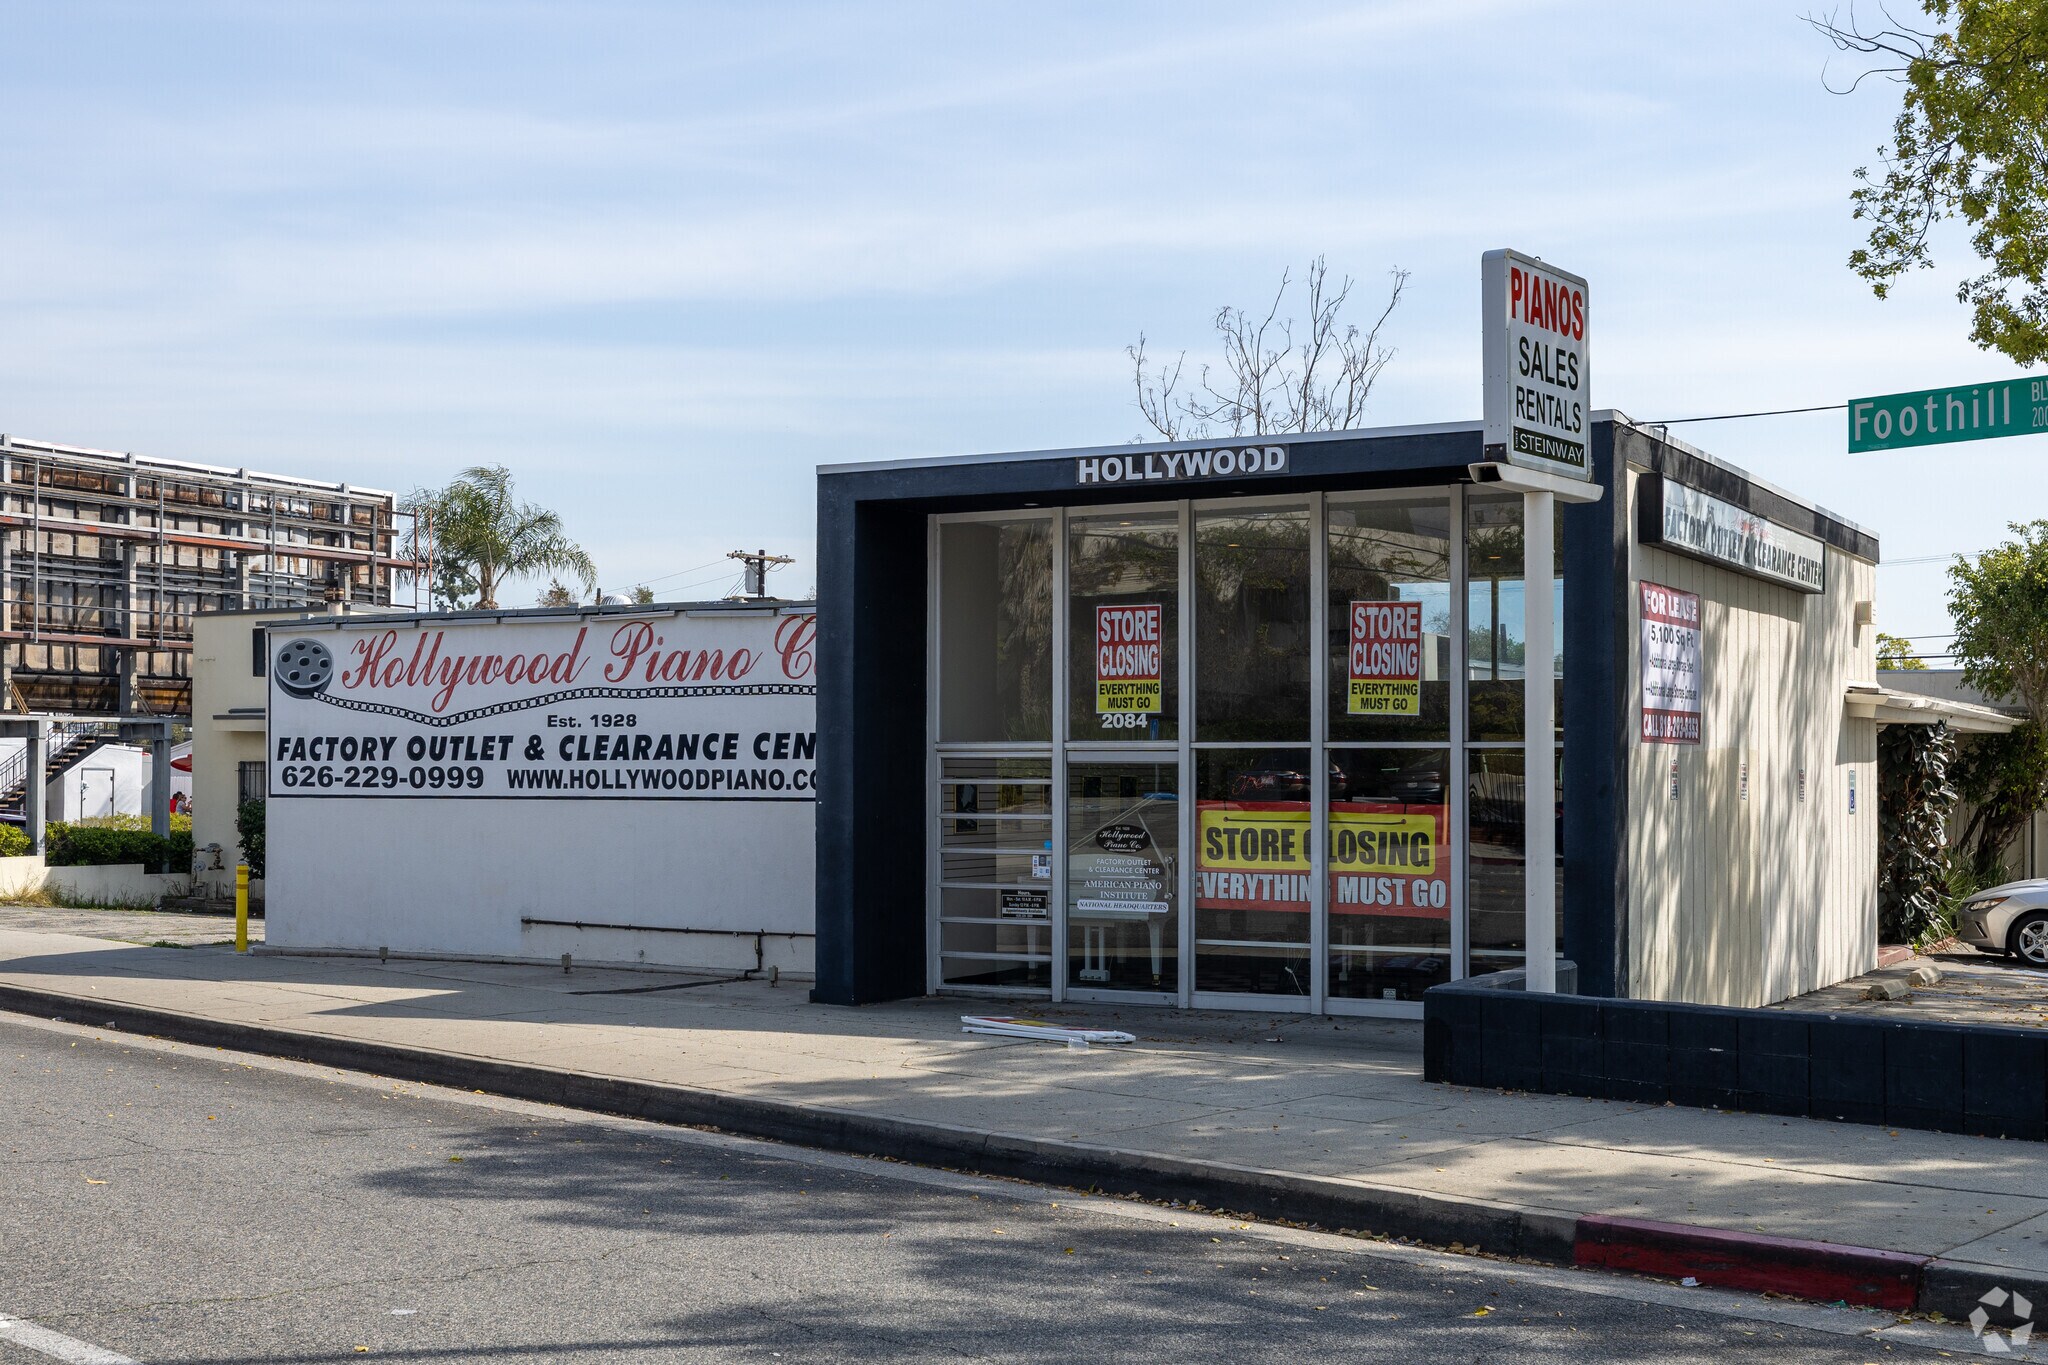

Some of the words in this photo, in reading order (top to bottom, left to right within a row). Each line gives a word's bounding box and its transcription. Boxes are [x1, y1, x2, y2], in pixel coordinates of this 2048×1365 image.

[1511, 266, 1584, 341] PIANOS
[1518, 336, 1579, 391] SALES
[1516, 385, 1582, 434] RENTALS
[1854, 385, 2010, 441] Foothill
[2031, 380, 2048, 402] BL
[1519, 433, 1584, 463] STEINWAY
[1078, 446, 1286, 484] HOLLYWOOD
[1664, 506, 1709, 549] FACTORY
[1744, 536, 1751, 564] &
[1753, 540, 1796, 579] CLEARANCE
[1797, 555, 1822, 587] CENTER
[1644, 589, 1667, 616] FOR
[1668, 595, 1698, 623] LEASE
[1100, 609, 1159, 642] STORE
[1353, 606, 1419, 639] STORE
[1650, 624, 1675, 645] 5,100
[1676, 629, 1686, 652] Sq
[1686, 631, 1695, 648] Ft
[341, 626, 591, 713] Hollywood
[603, 621, 764, 684] Piano
[774, 614, 817, 680] C
[1099, 644, 1159, 676] CLOSING
[1352, 642, 1418, 676] CLOSING
[1099, 683, 1160, 695] EVERYTHING
[1107, 697, 1134, 709] MUST
[1136, 697, 1151, 709] GO
[1351, 683, 1418, 696] EVERYTHING
[1360, 698, 1390, 710] MUST
[1392, 698, 1408, 710] GO
[546, 714, 582, 728] Est.
[589, 713, 638, 728] 1928
[1101, 713, 1148, 729] 2084
[1643, 713, 1659, 738] CALL
[276, 736, 398, 762] FACTORY
[406, 735, 514, 761] OUTLET
[523, 734, 545, 761] &
[558, 733, 740, 762] CLEARANCE
[281, 765, 485, 788] 626-229-0999
[1099, 829, 1146, 841] Hollywood
[1103, 839, 1128, 849] Piano
[1129, 840, 1142, 849] Co.
[1205, 827, 1296, 863] STORE
[1095, 866, 1133, 874] CLEARANCE
[1134, 867, 1160, 875] CENTER
[1096, 858, 1126, 866] FACTORY
[1083, 880, 1132, 889] AMERICAN
[1133, 881, 1162, 890] PIANO
[1099, 891, 1148, 900] INSTITUTE
[1196, 871, 1331, 903] VERYTHIN
[1337, 875, 1406, 907] MUST
[1411, 878, 1448, 909] GO
[1078, 900, 1113, 909] NATIONAL
[1113, 902, 1168, 911] HEADQUARTERS
